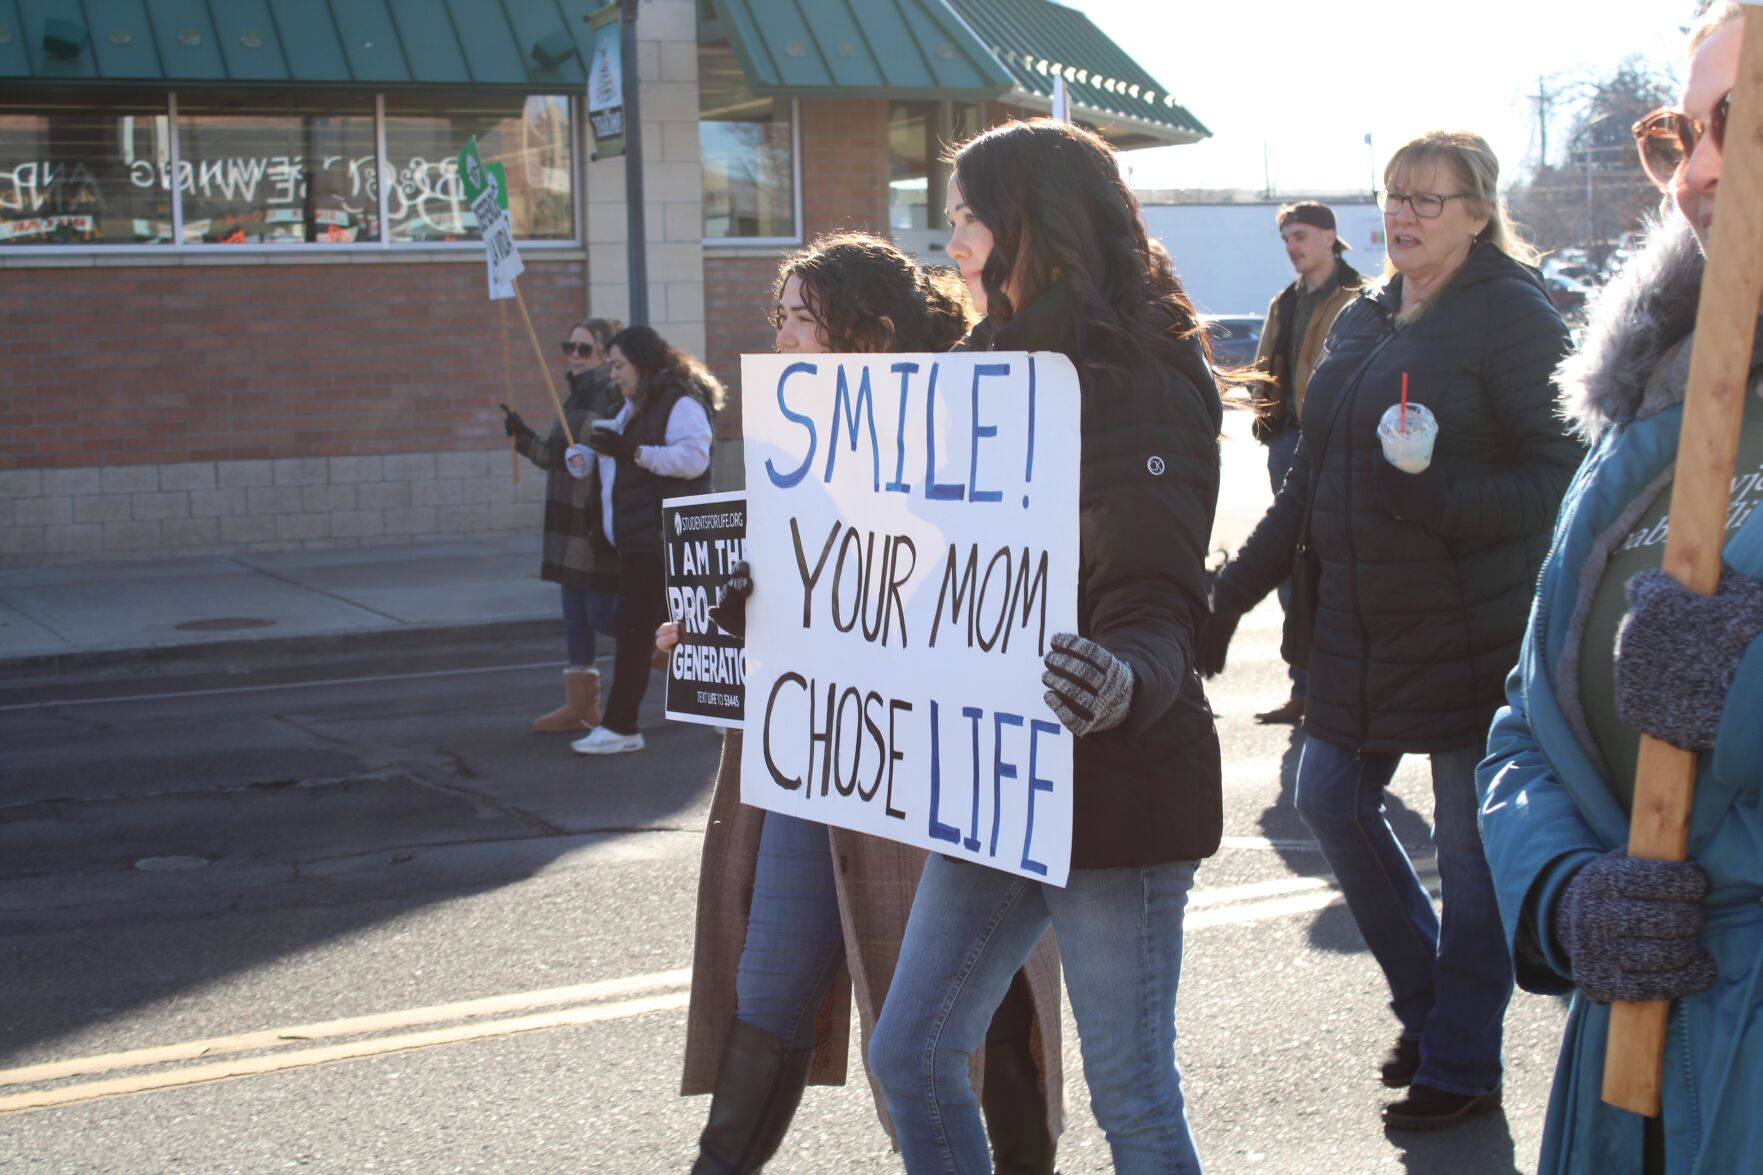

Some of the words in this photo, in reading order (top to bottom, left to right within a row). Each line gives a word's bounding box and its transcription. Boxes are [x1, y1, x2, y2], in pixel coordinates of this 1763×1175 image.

[764, 356, 1036, 509] SMILE!
[668, 542, 676, 577] I
[683, 540, 710, 576] AM
[682, 512, 744, 532] STUDENTSFORLIFE.ORG
[789, 515, 917, 650] YOUR
[928, 543, 1050, 657] MOM
[763, 671, 914, 821] CHOSE
[928, 699, 1062, 877] LIFE
